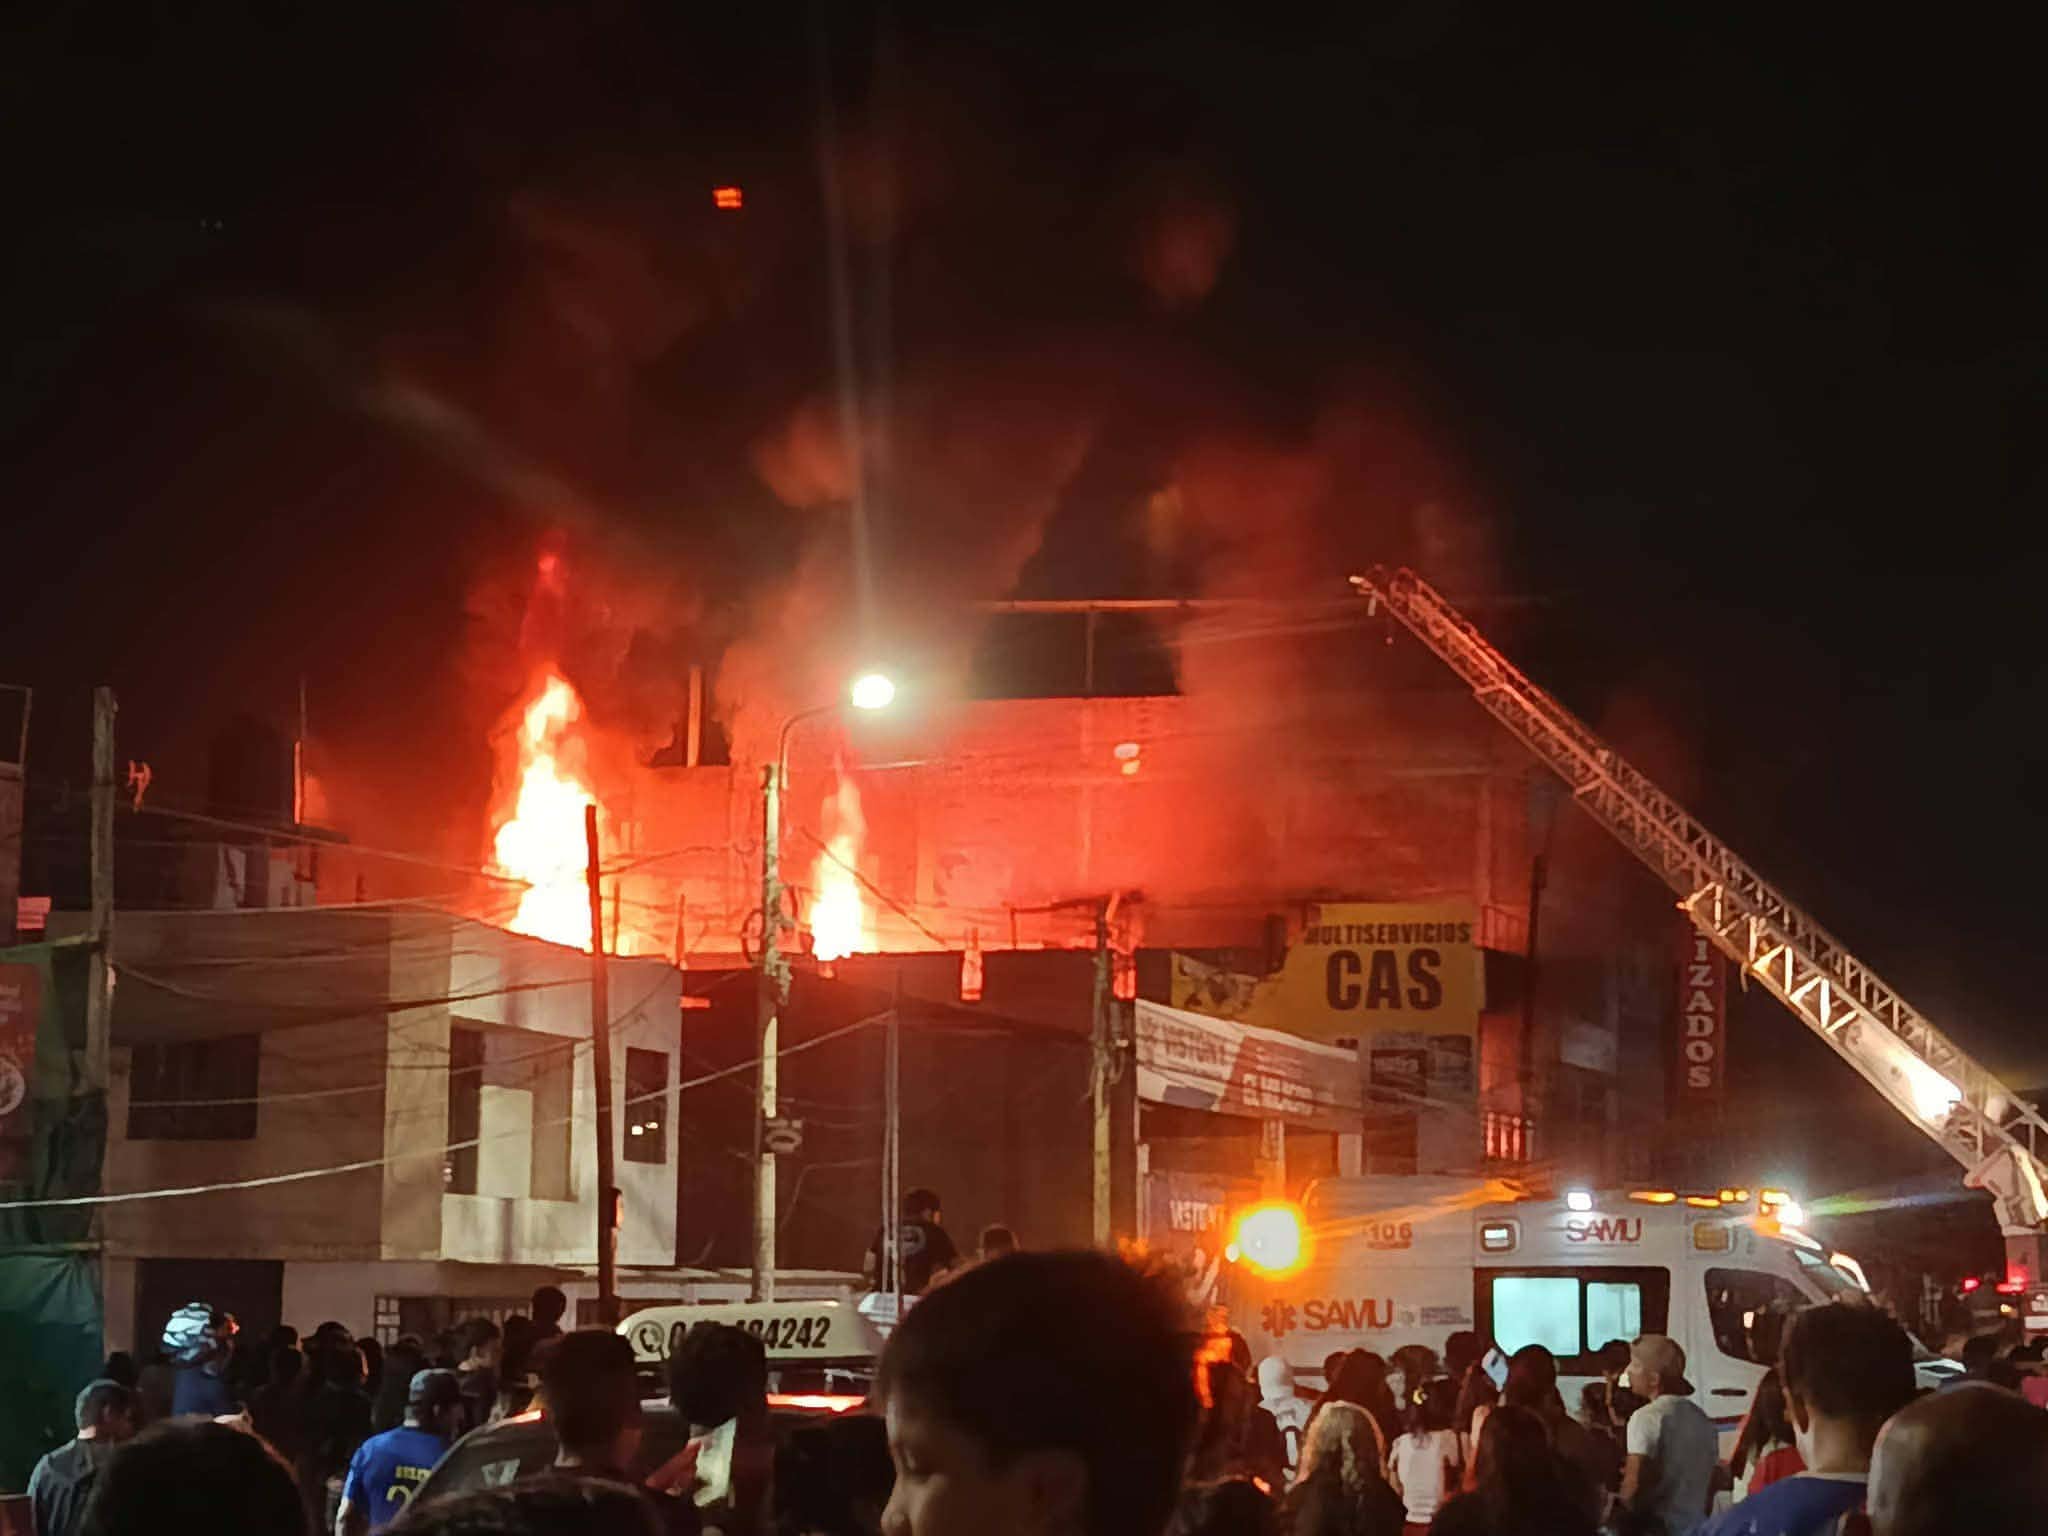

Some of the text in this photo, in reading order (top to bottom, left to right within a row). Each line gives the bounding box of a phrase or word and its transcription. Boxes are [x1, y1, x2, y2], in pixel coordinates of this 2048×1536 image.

[1326, 948, 1443, 1010] CAS
[1685, 929, 1714, 1088] IZADOS
[1369, 1222, 1413, 1240] 106
[1566, 1217, 1641, 1241] SAMU
[1303, 1298, 1394, 1330] SAMU
